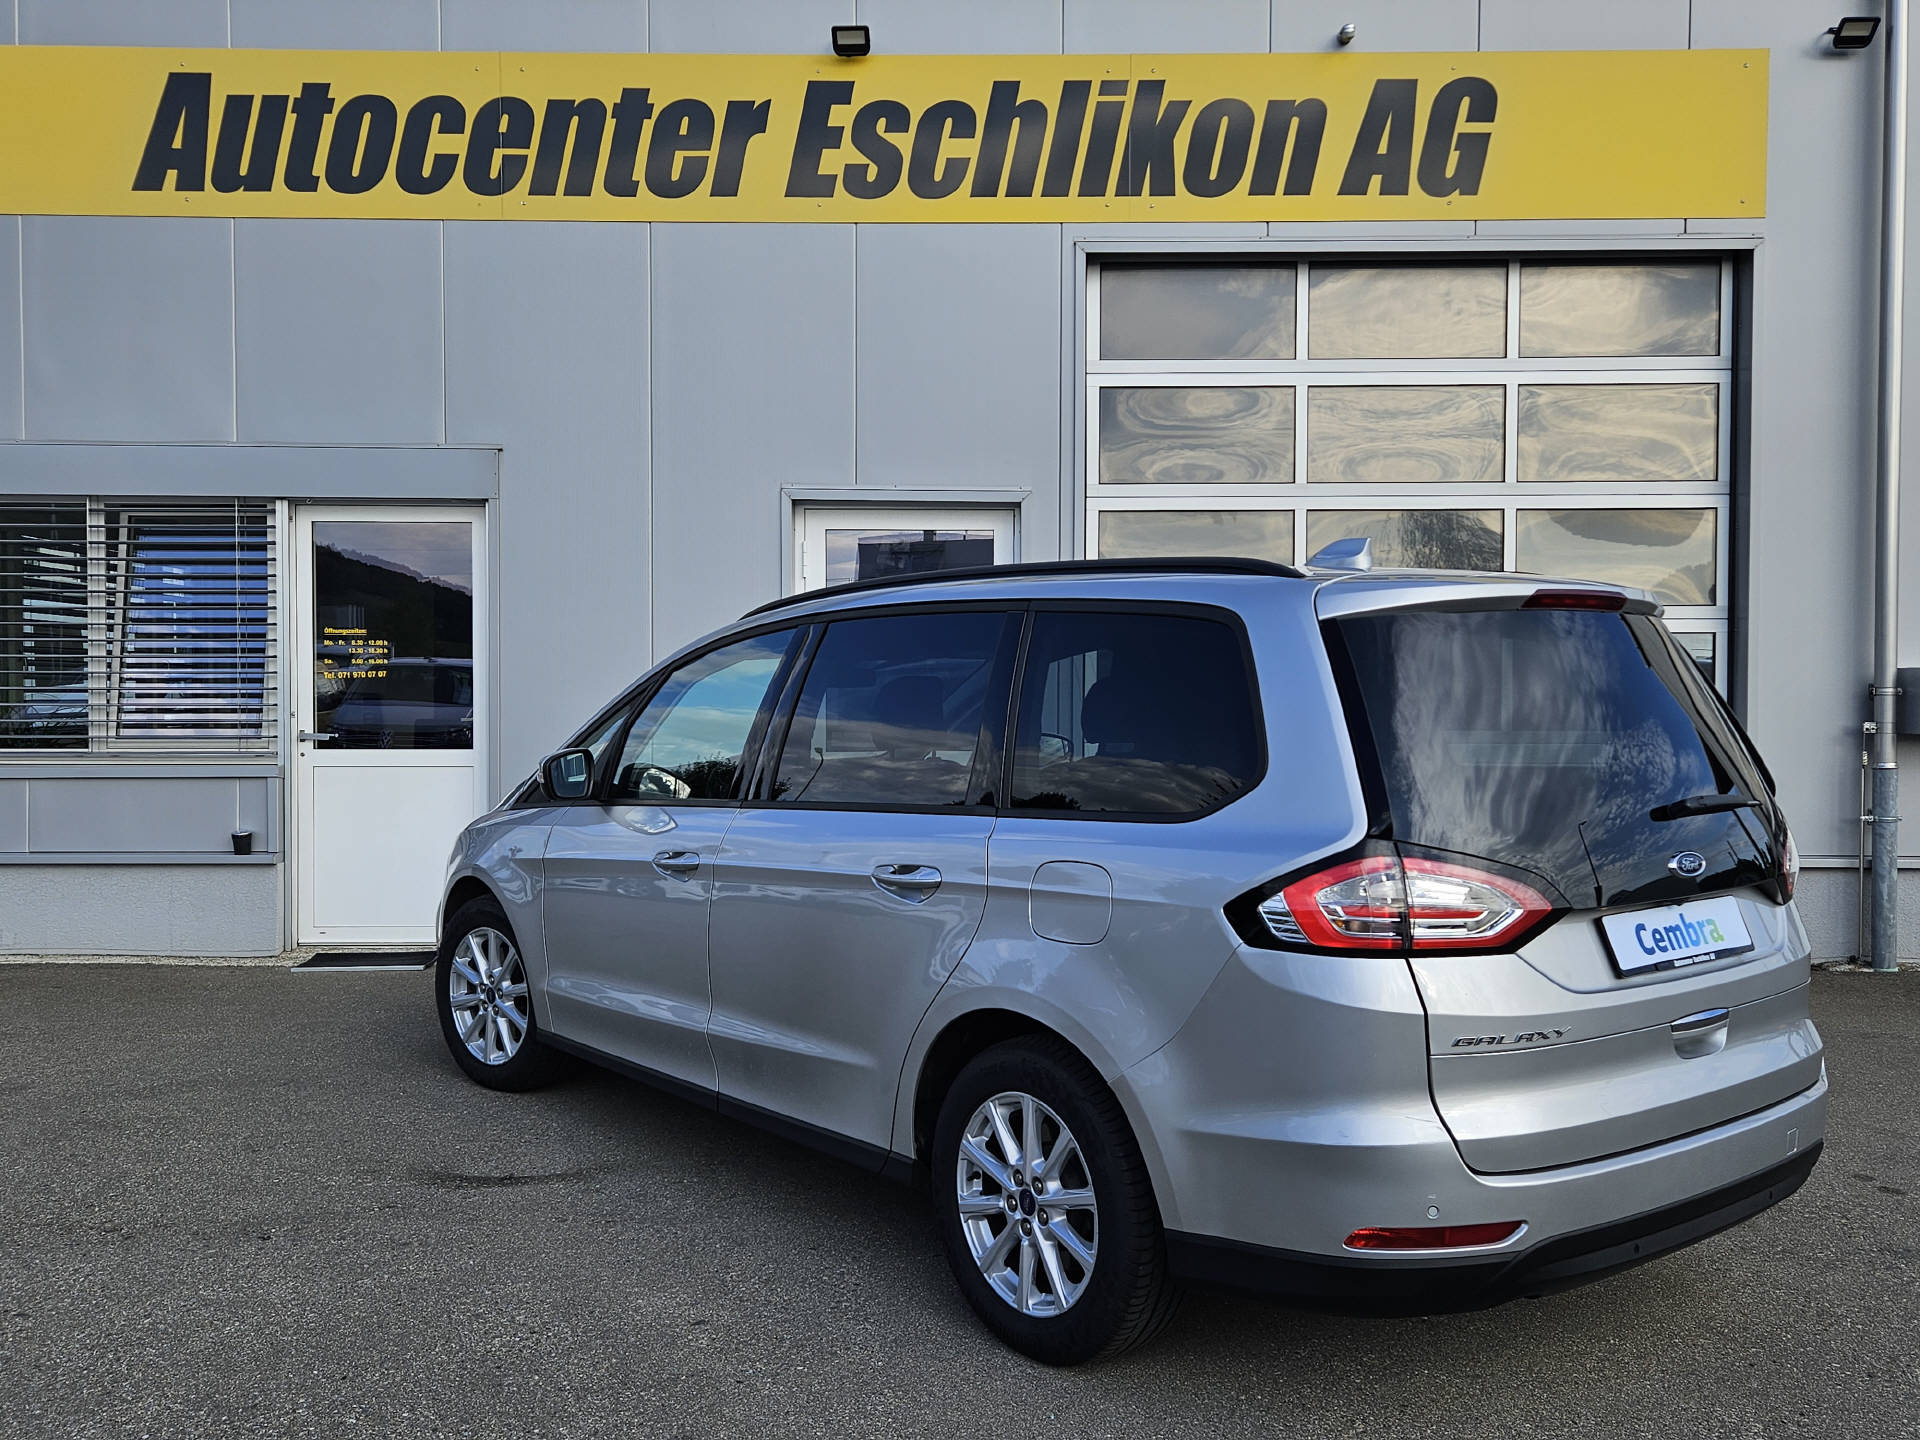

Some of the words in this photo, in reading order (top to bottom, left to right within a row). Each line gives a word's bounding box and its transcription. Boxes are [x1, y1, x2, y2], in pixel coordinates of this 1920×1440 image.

[131, 72, 771, 198] Autocenter
[784, 80, 1328, 199] Eschlikon
[1337, 76, 1498, 198] AG
[324, 671, 336, 679] Tel.
[337, 671, 350, 679] 071
[352, 671, 366, 679] 970
[378, 670, 387, 678] 07
[1635, 912, 1725, 955] Cembra
[1451, 1026, 1572, 1048] GALAXY
